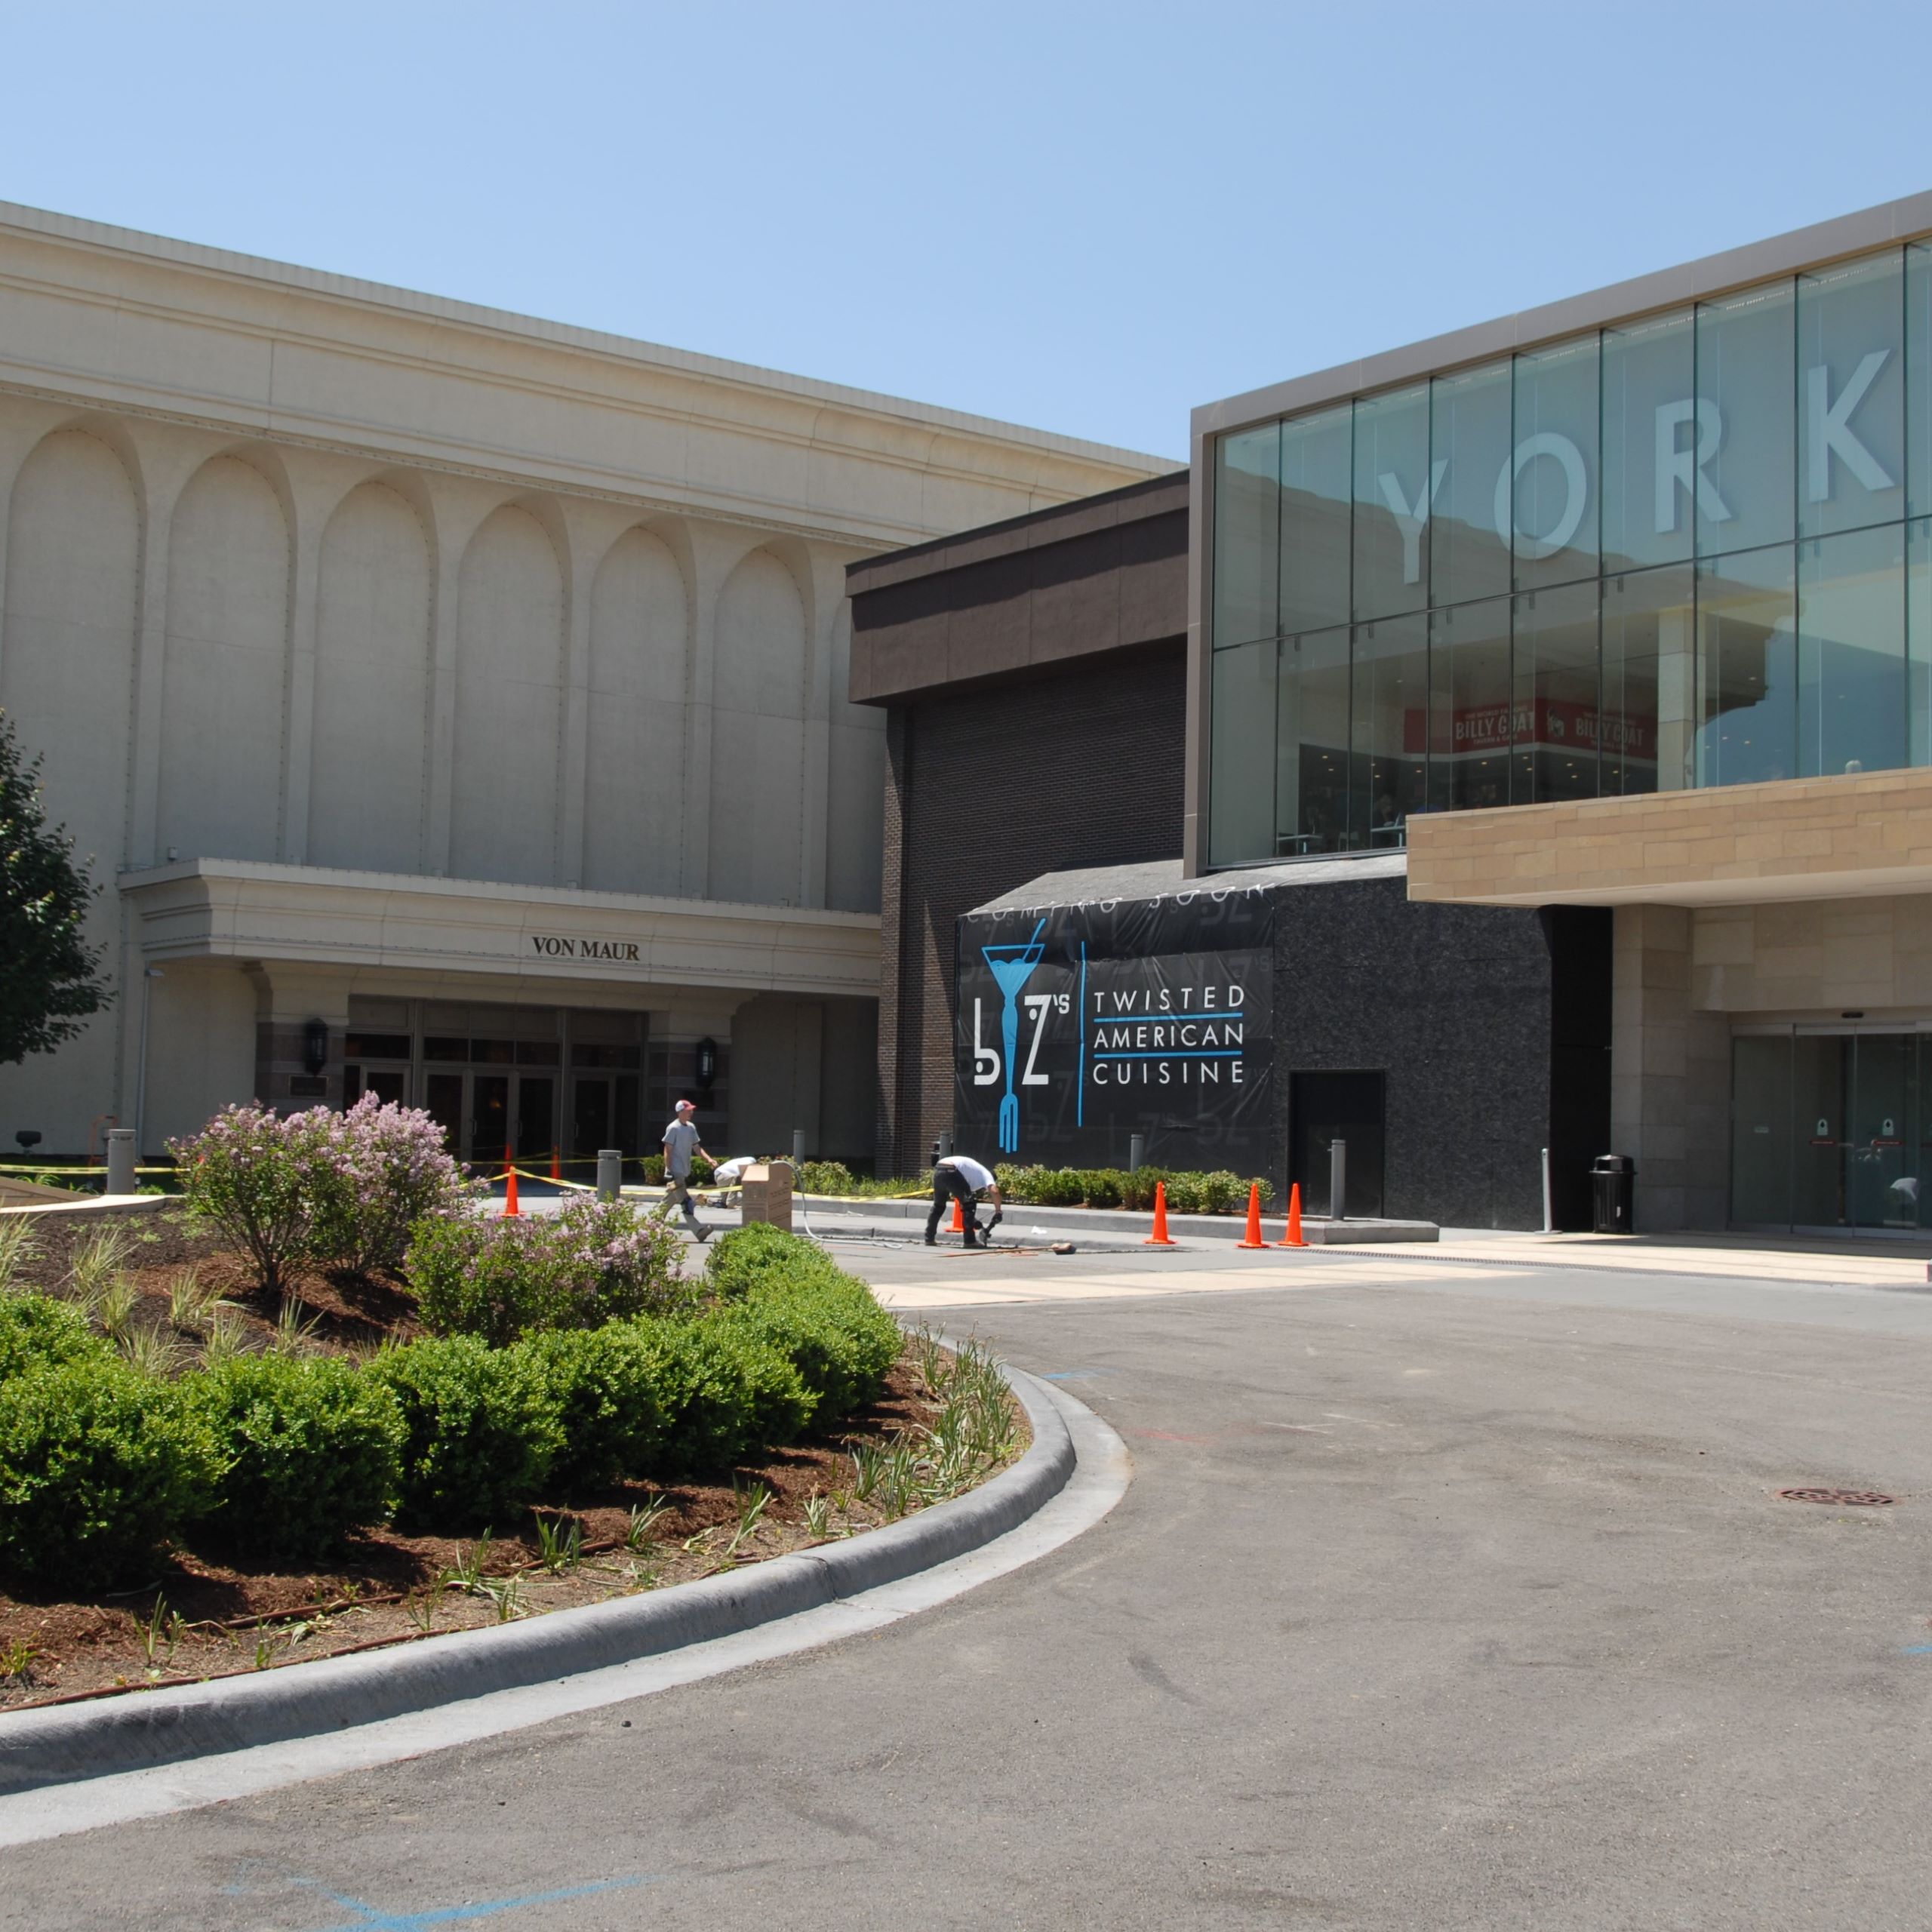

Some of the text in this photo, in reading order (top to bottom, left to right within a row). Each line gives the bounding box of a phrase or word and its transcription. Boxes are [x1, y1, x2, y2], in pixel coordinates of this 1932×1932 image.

[1379, 349, 1894, 585] YORK
[1455, 718, 1494, 740] BILLY
[532, 937, 640, 961] VON MAUR
[1094, 985, 1244, 1013] TWISTED
[1094, 1023, 1244, 1049] AMERICAN
[1094, 1060, 1244, 1085] CUISINE
